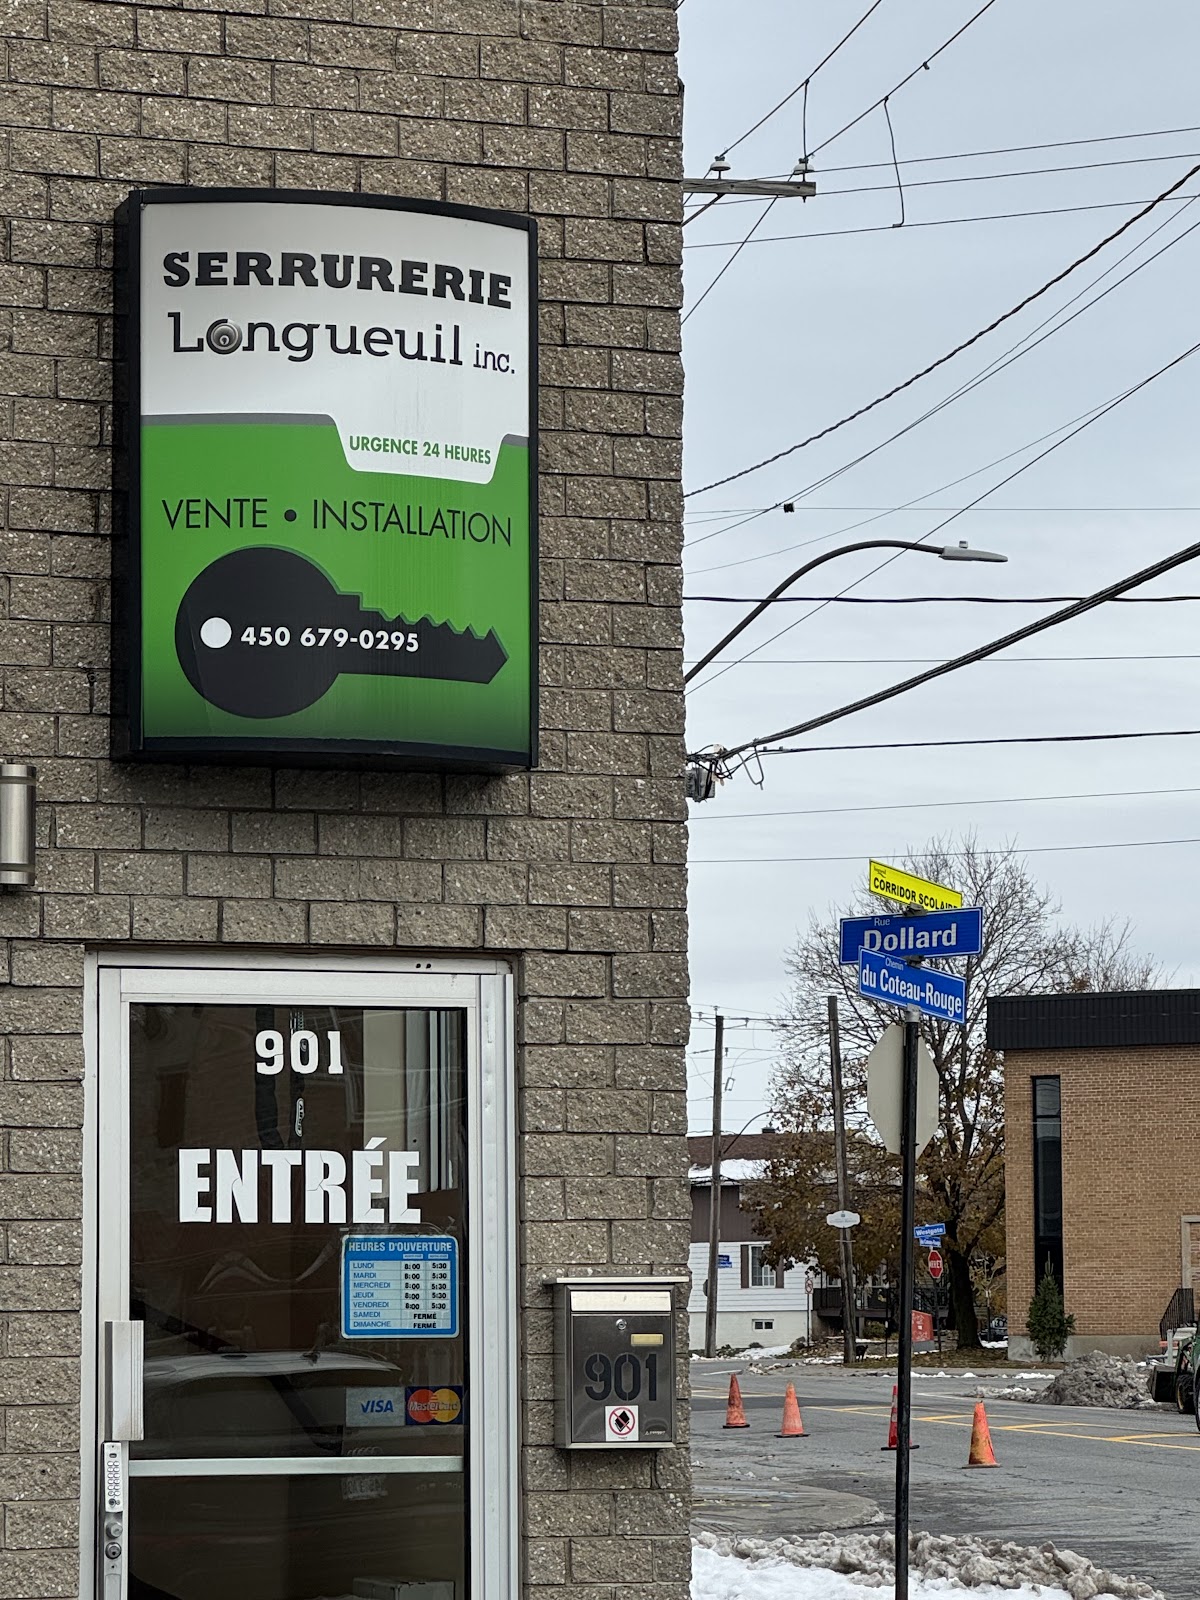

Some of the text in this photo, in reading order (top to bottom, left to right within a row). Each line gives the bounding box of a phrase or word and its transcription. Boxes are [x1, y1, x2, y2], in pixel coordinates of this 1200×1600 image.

[162, 250, 511, 309] SERRURERIE
[168, 311, 515, 374] Longueuil inc.
[349, 435, 491, 465] URGENCE 24 HEURES
[162, 498, 512, 547] VENTE INSTALLATION
[240, 626, 420, 653] 450 679-0295
[873, 877, 916, 903] CORRIDOR
[874, 917, 890, 926] Rue
[864, 922, 957, 951] Dollard
[862, 963, 962, 1018] du Coteau-Rouge
[255, 1029, 343, 1075] 901
[179, 1137, 421, 1225] ENTRÉE
[349, 1241, 452, 1252] HEURES D'OUVERTURE
[405, 1302, 420, 1310] 8:00
[413, 1321, 437, 1329] FERMÉ
[585, 1352, 657, 1401] 901
[360, 1399, 394, 1413] VISA
[410, 1400, 458, 1411] MasterCard
